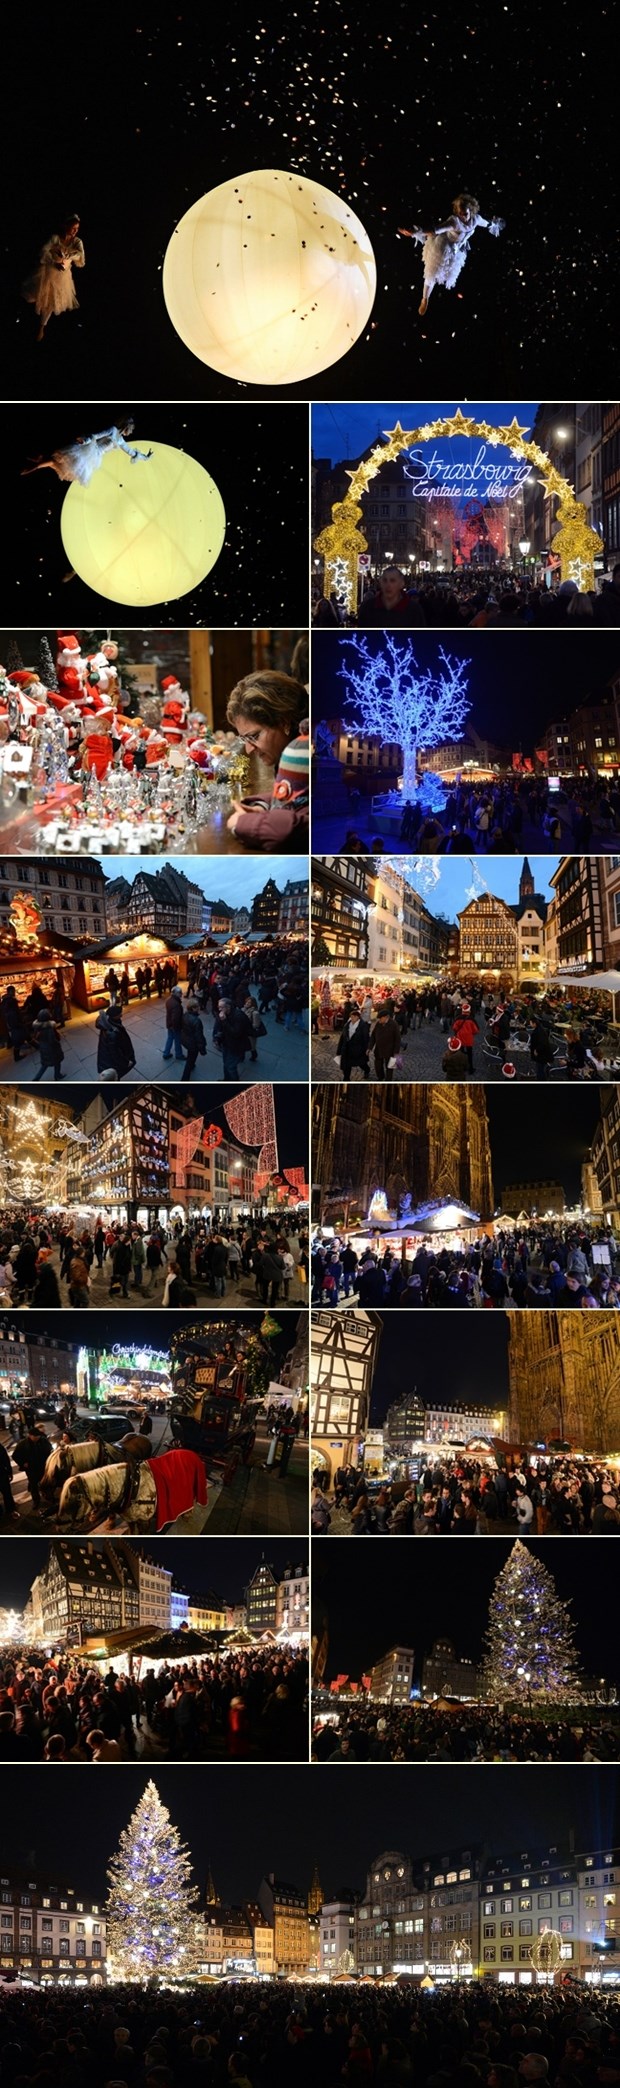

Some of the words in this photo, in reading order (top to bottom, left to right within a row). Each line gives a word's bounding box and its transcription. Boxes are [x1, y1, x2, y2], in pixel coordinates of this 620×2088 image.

[403, 445, 533, 498] Strasbourg
[411, 480, 461, 502] Capitale
[463, 483, 479, 498] de
